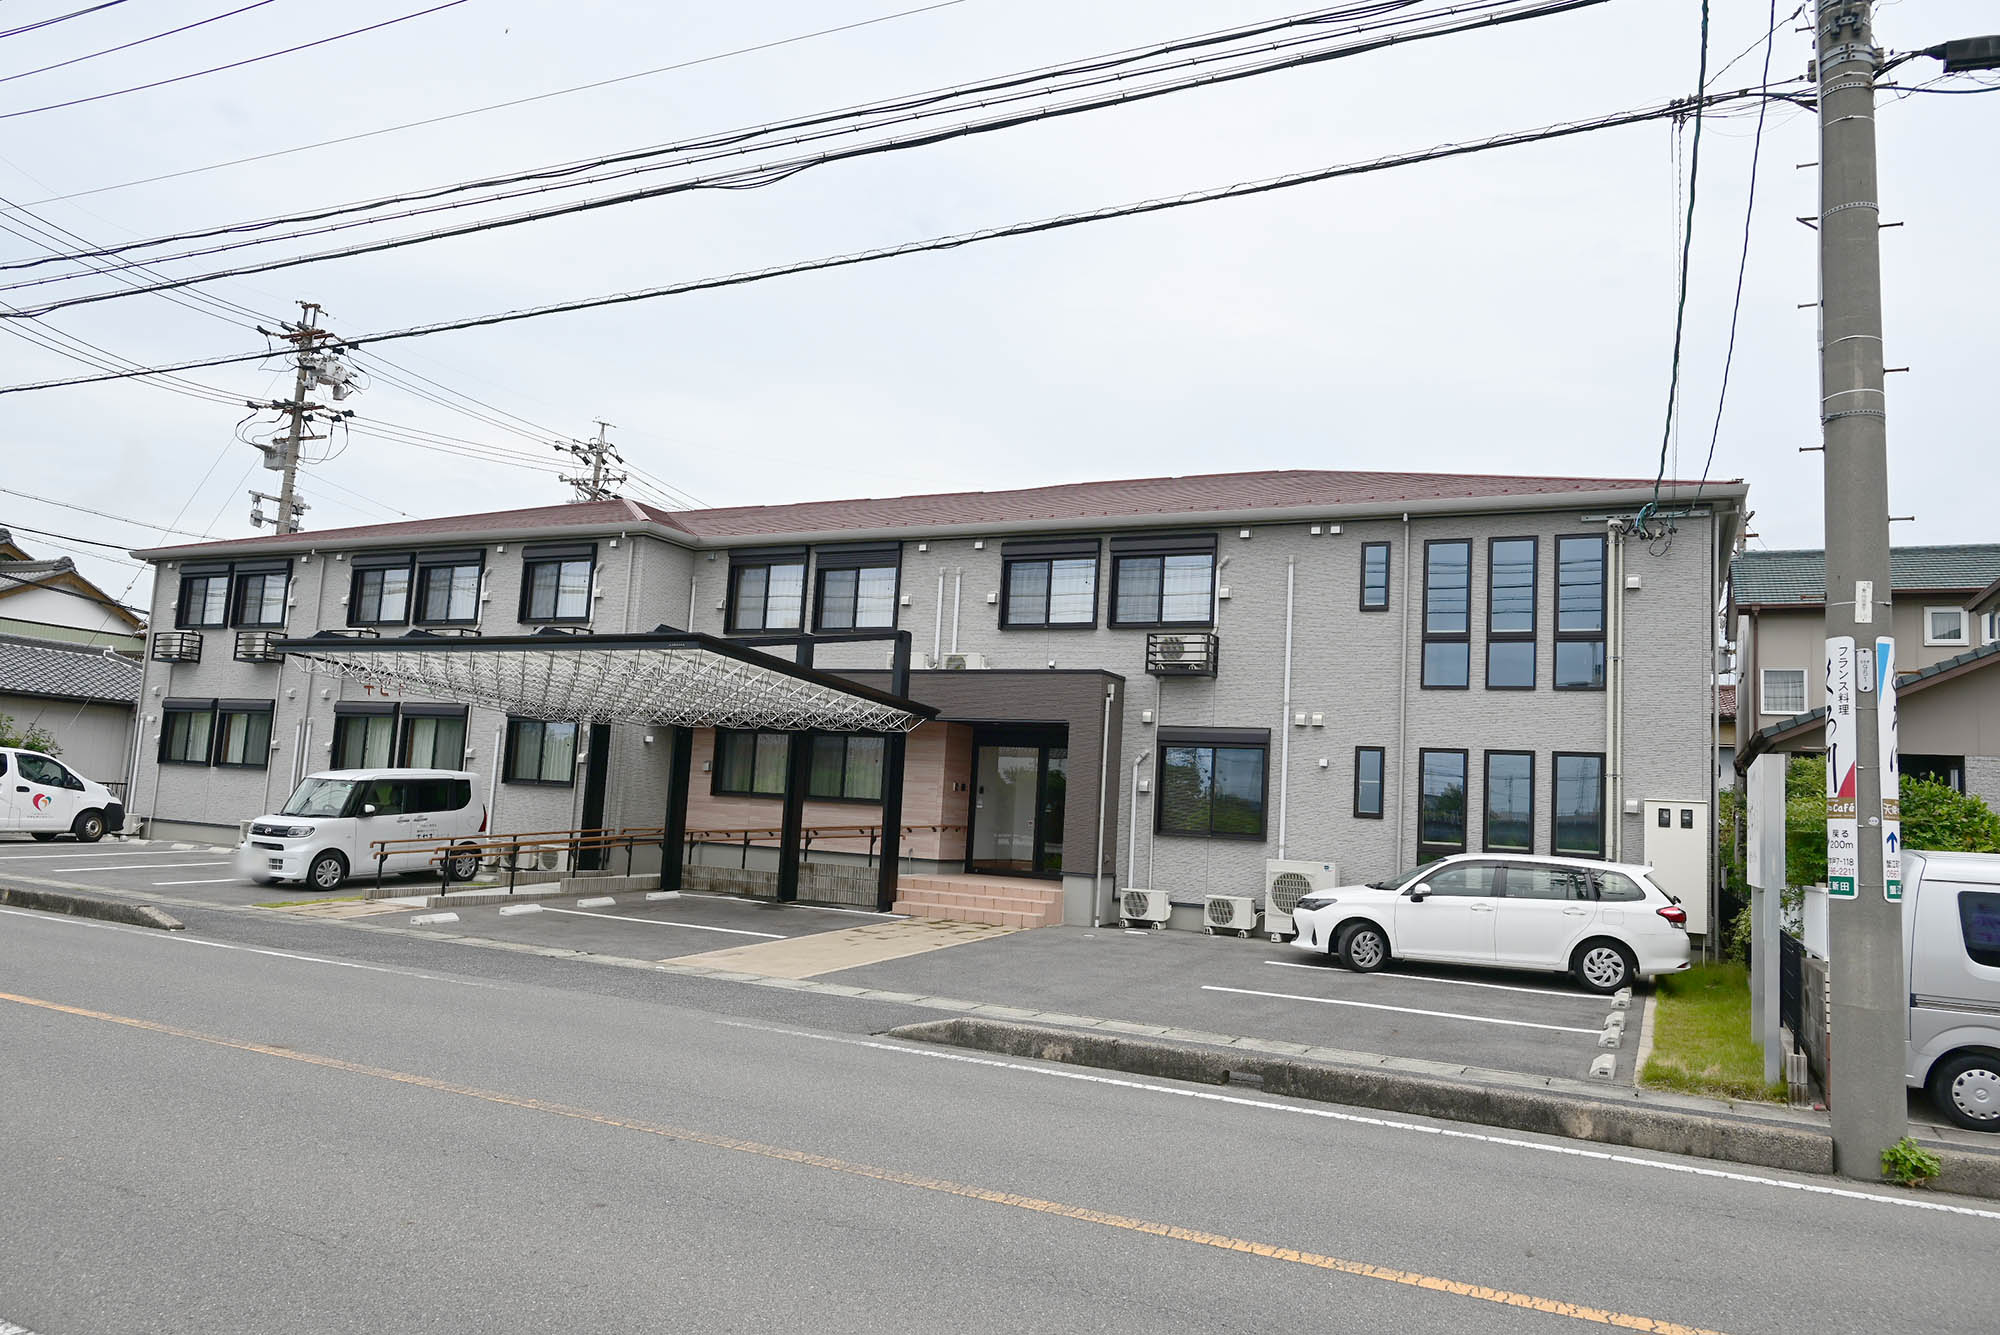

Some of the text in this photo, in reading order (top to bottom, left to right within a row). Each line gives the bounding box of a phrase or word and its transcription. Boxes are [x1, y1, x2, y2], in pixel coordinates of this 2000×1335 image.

[1838, 646, 1850, 716] フランス料理
[1831, 840, 1854, 849] 200m
